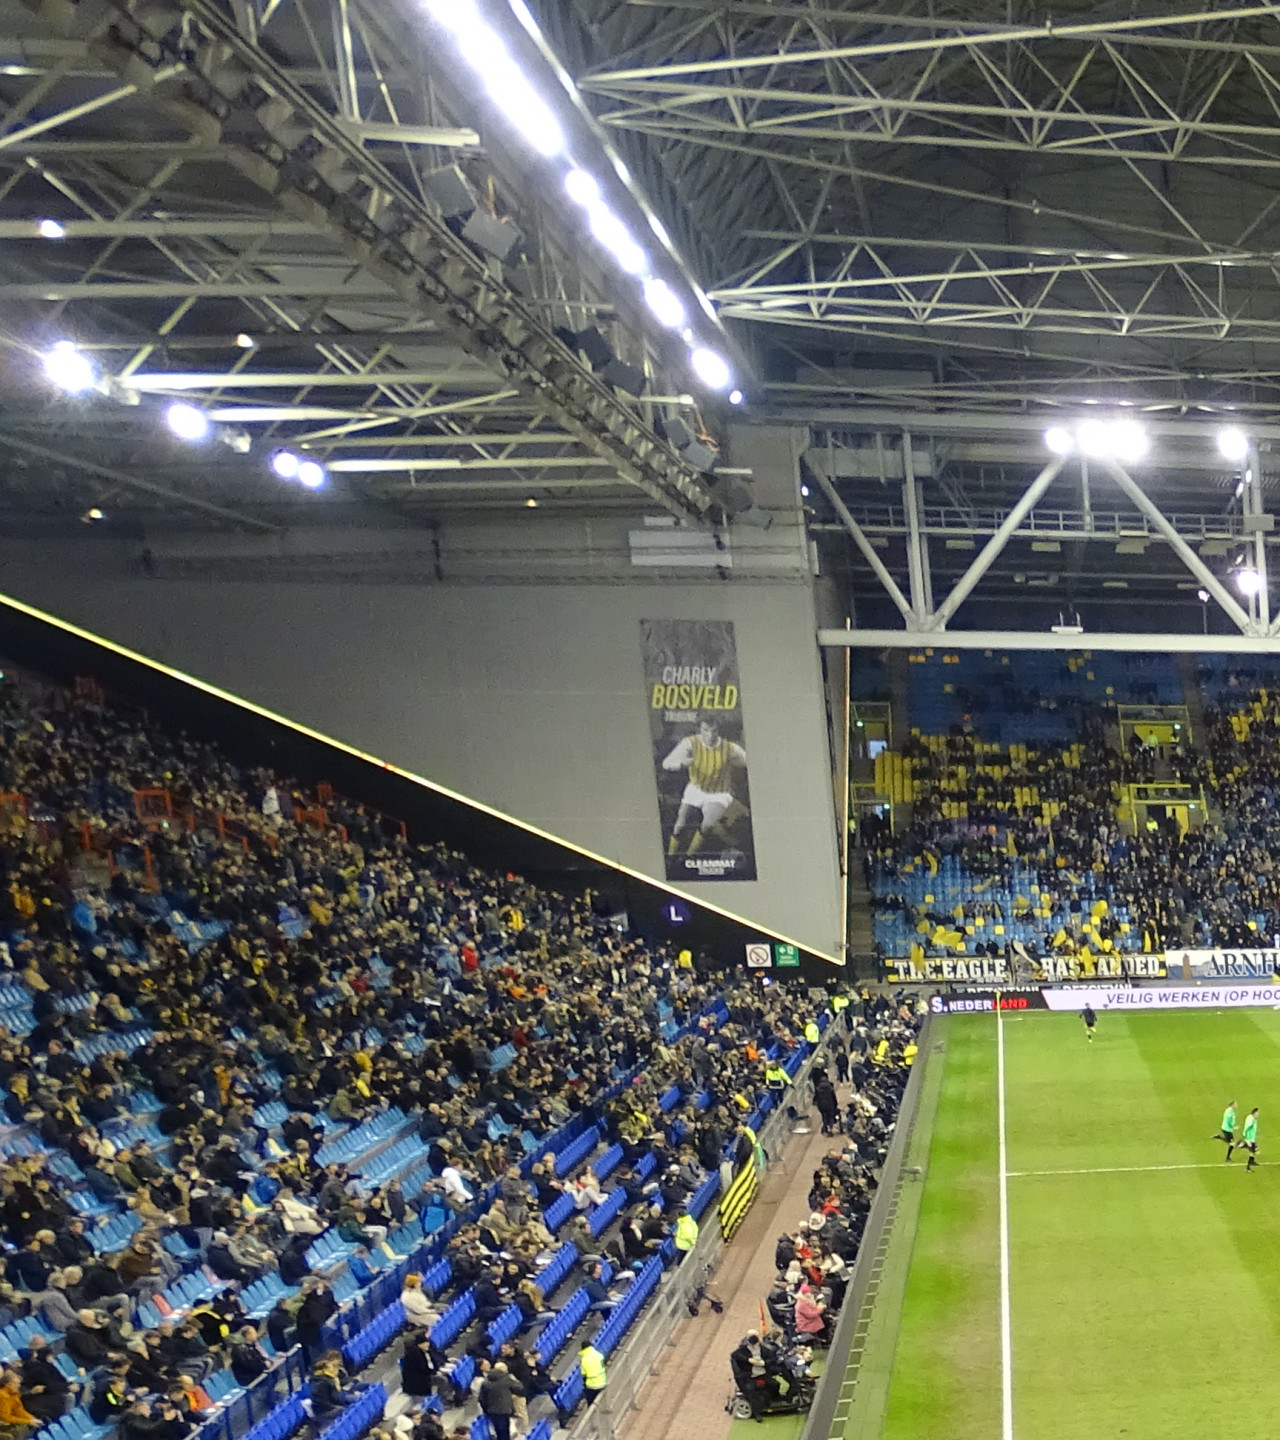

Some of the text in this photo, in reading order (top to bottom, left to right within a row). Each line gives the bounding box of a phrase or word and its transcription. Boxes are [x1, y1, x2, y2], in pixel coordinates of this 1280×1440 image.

[662, 665, 717, 685] CHARLY
[652, 684, 738, 710] BOSVELD
[669, 906, 683, 922] L
[943, 957, 1007, 978] EAGLE
[1106, 992, 1156, 1006] VEILIG
[1159, 990, 1221, 1004] WERKEN
[1224, 990, 1248, 1005] (OP
